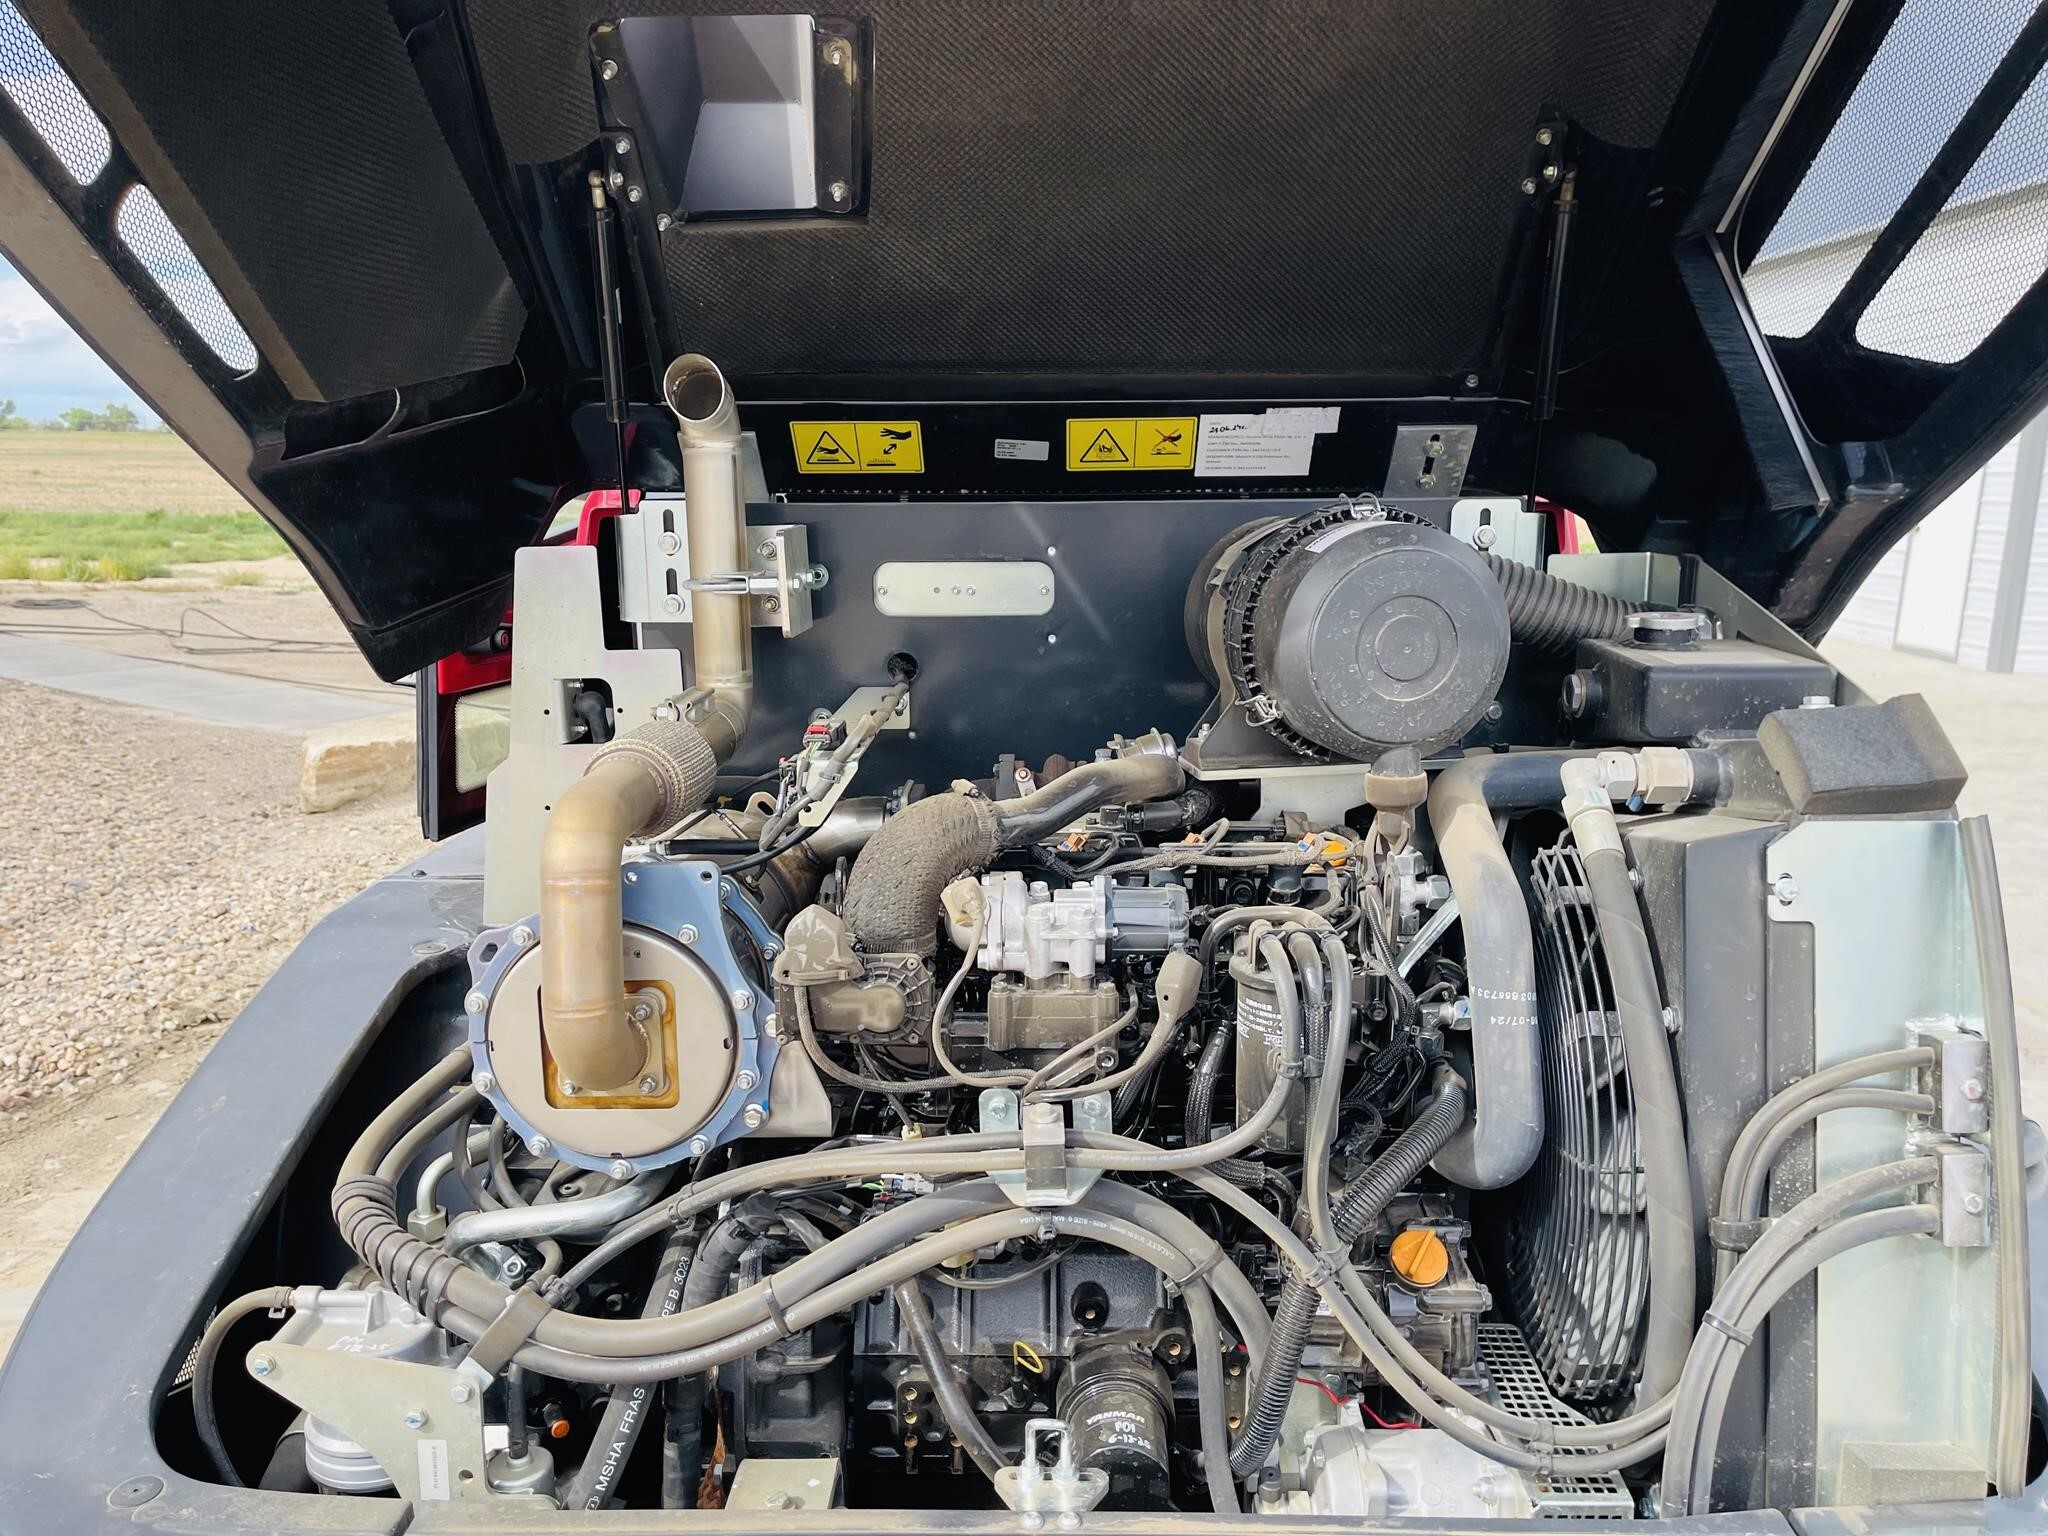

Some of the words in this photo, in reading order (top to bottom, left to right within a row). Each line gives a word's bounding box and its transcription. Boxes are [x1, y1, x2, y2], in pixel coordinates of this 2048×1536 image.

[668, 1289, 680, 1300] B
[1086, 1411, 1145, 1425] YANMAR
[595, 1441, 626, 1491] MSHA
[619, 1387, 645, 1433] FRAS
